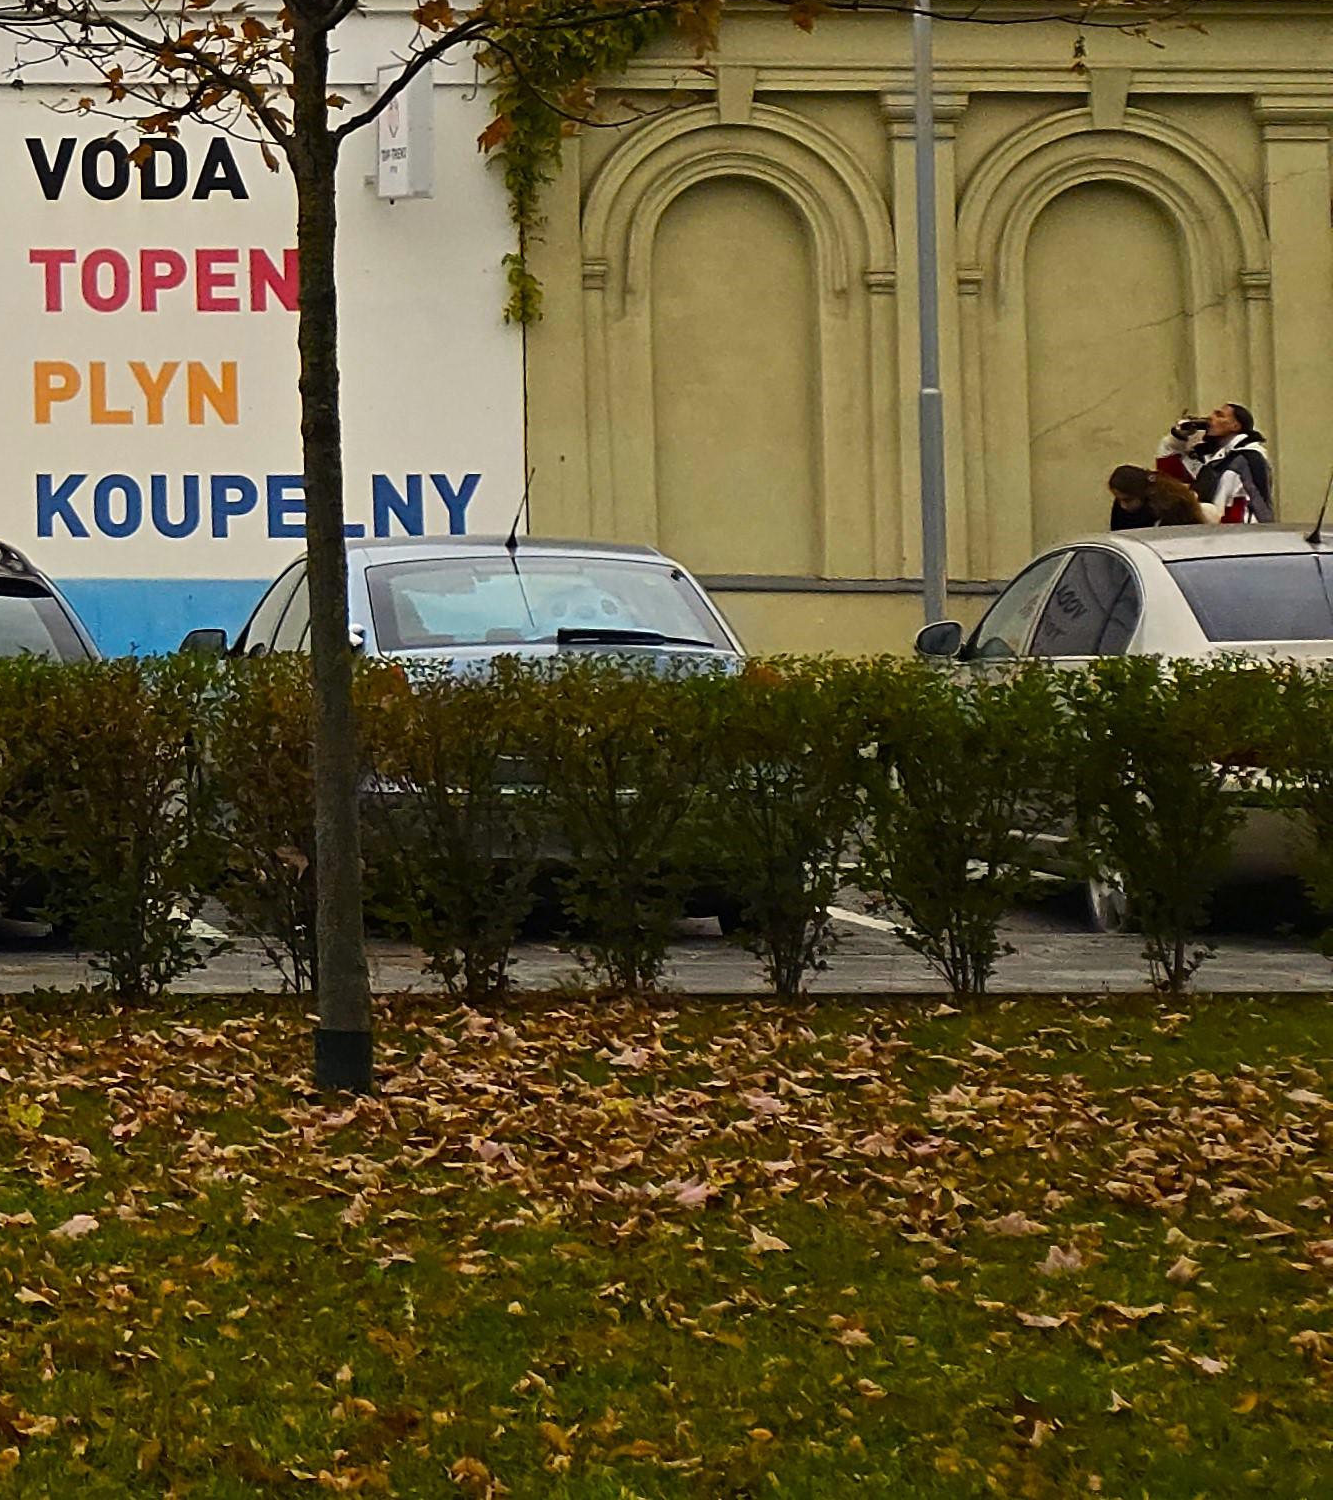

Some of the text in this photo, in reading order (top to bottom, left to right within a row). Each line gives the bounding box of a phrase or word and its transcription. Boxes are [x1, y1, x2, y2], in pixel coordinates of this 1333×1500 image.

[26, 137, 249, 200] VODA
[30, 248, 300, 312] TOPEN
[34, 361, 238, 424] PLYN
[36, 474, 481, 538] KOUPENY
